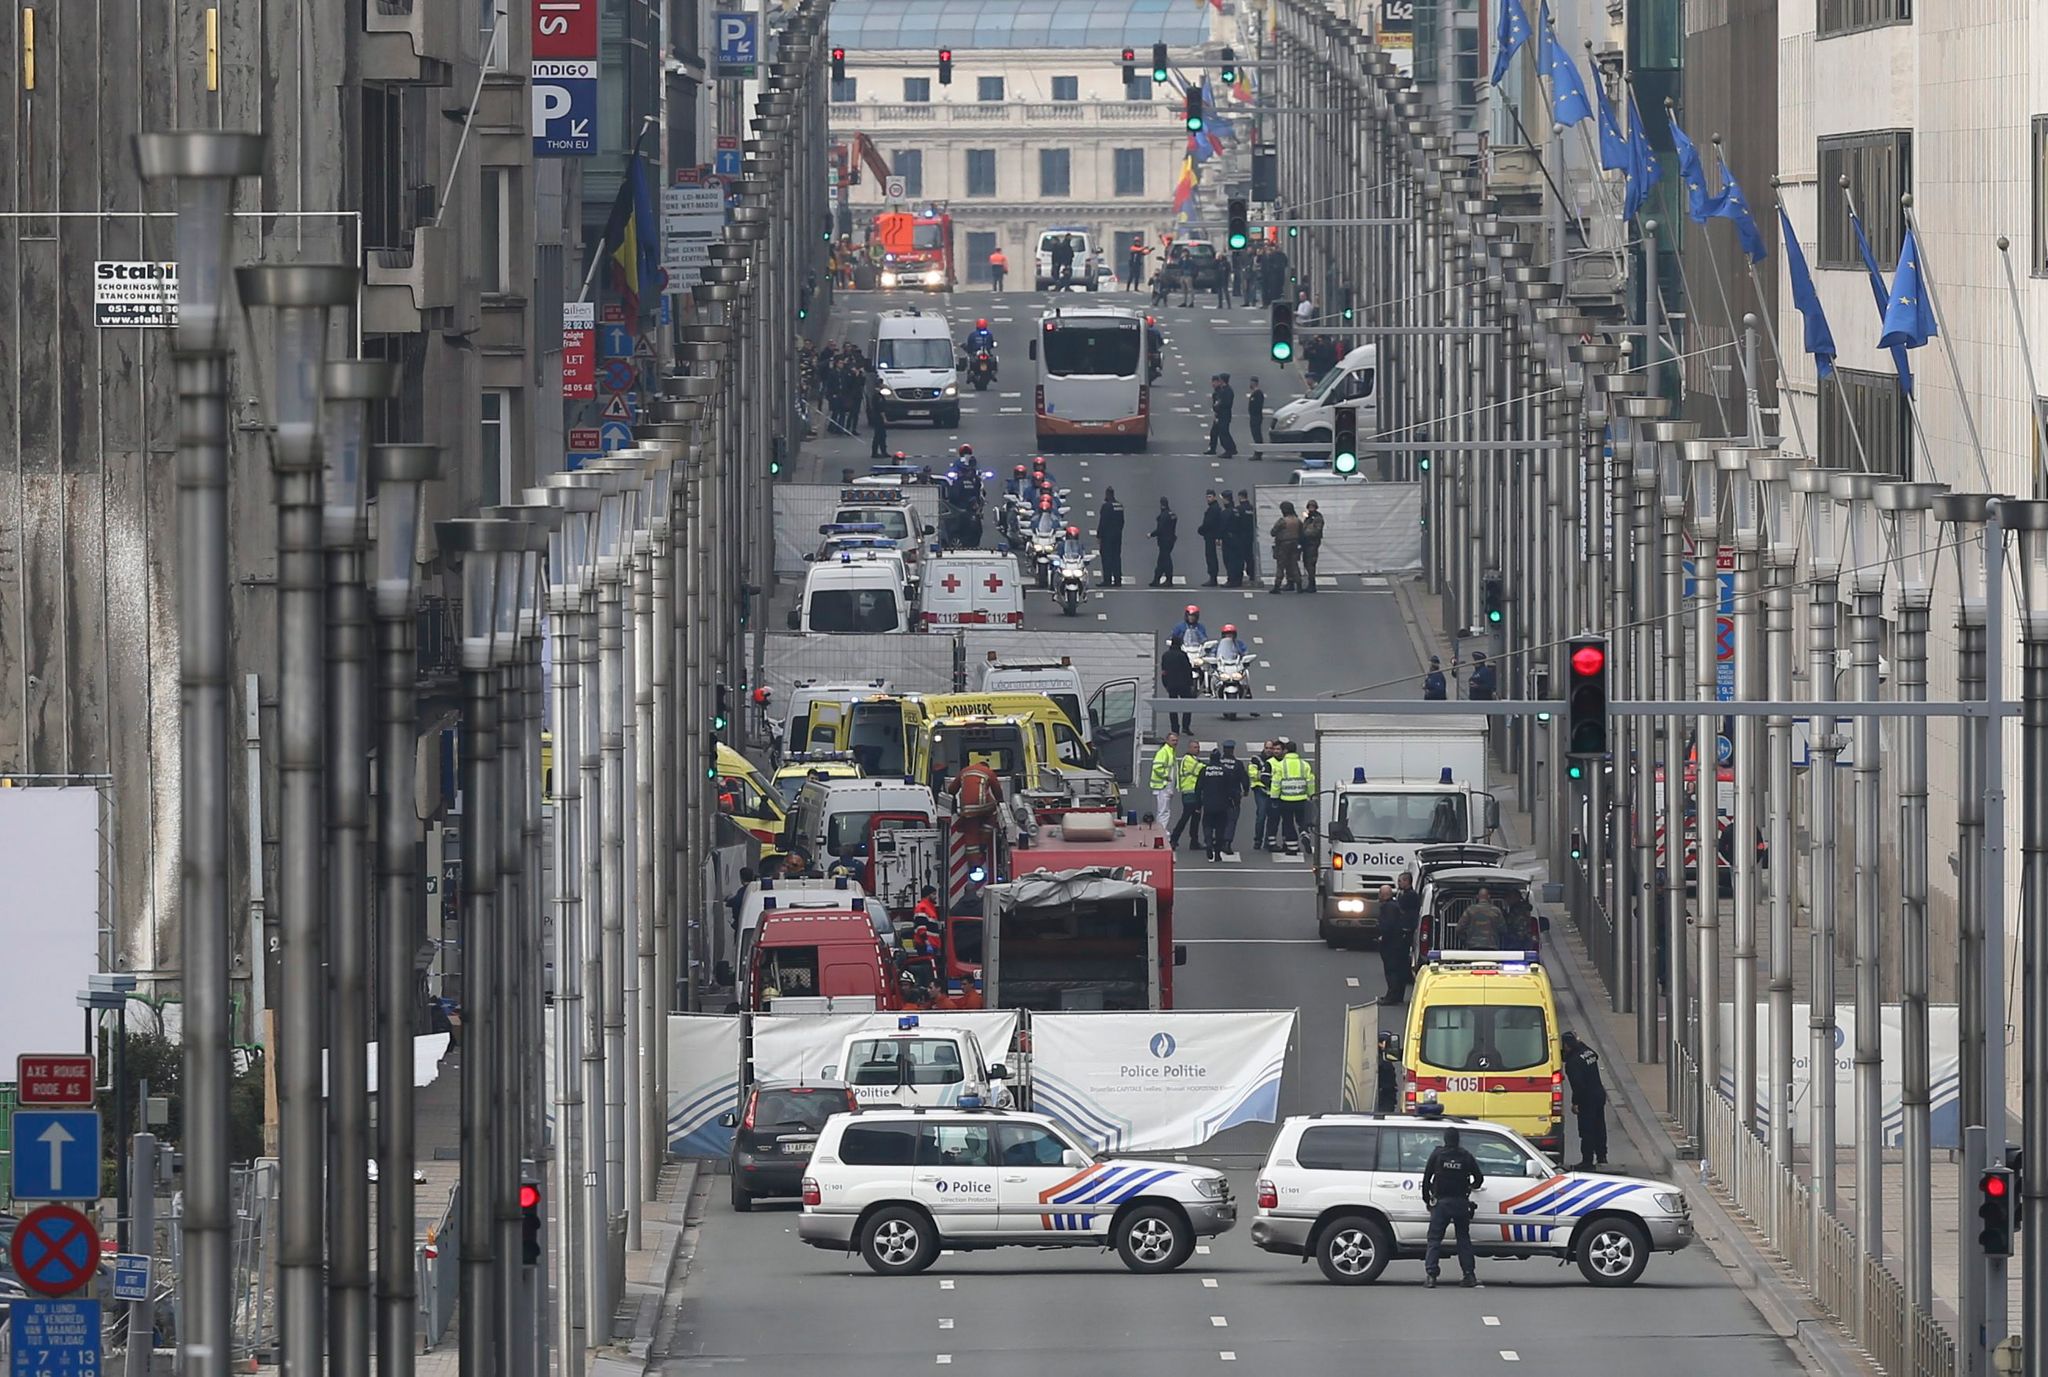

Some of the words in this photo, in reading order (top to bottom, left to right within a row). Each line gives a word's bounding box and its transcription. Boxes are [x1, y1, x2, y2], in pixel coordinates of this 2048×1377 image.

[1386, 1, 1413, 19] L42
[721, 19, 746, 50] P
[533, 64, 589, 77] INDIGO
[532, 85, 572, 137] P
[547, 140, 573, 149] THON
[575, 140, 589, 149] EU
[108, 305, 146, 313] 051-48
[148, 305, 162, 313] 08
[165, 305, 179, 313] 30
[584, 321, 593, 330] 00
[563, 331, 584, 340] Knight
[566, 355, 583, 364] LET
[942, 613, 959, 624] 112
[990, 613, 1007, 624] 112
[946, 703, 994, 717] POMPIERS
[1363, 852, 1405, 865] Police
[1123, 866, 1153, 882] Car
[1792, 1057, 1808, 1068] Pol
[26, 1065, 48, 1078] AXE
[53, 1065, 87, 1078] ROUGE
[1120, 1065, 1159, 1077] Police
[1163, 1064, 1206, 1077] Politie
[32, 1083, 60, 1095] RODE
[66, 1083, 81, 1095] AS
[1456, 1077, 1478, 1092] 105
[855, 1087, 890, 1098] Politie
[953, 1181, 992, 1193] Police
[34, 1304, 46, 1313] DU
[51, 1304, 76, 1313] LUNDI
[27, 1314, 39, 1323] AU
[43, 1314, 84, 1323] VENDREDI
[24, 1325, 41, 1334] VAN
[46, 1325, 87, 1334] MAANDAG
[27, 1336, 42, 1345] TOT
[48, 1335, 84, 1345] VRIJDAG
[38, 1351, 49, 1364] 7
[79, 1350, 95, 1364] 13
